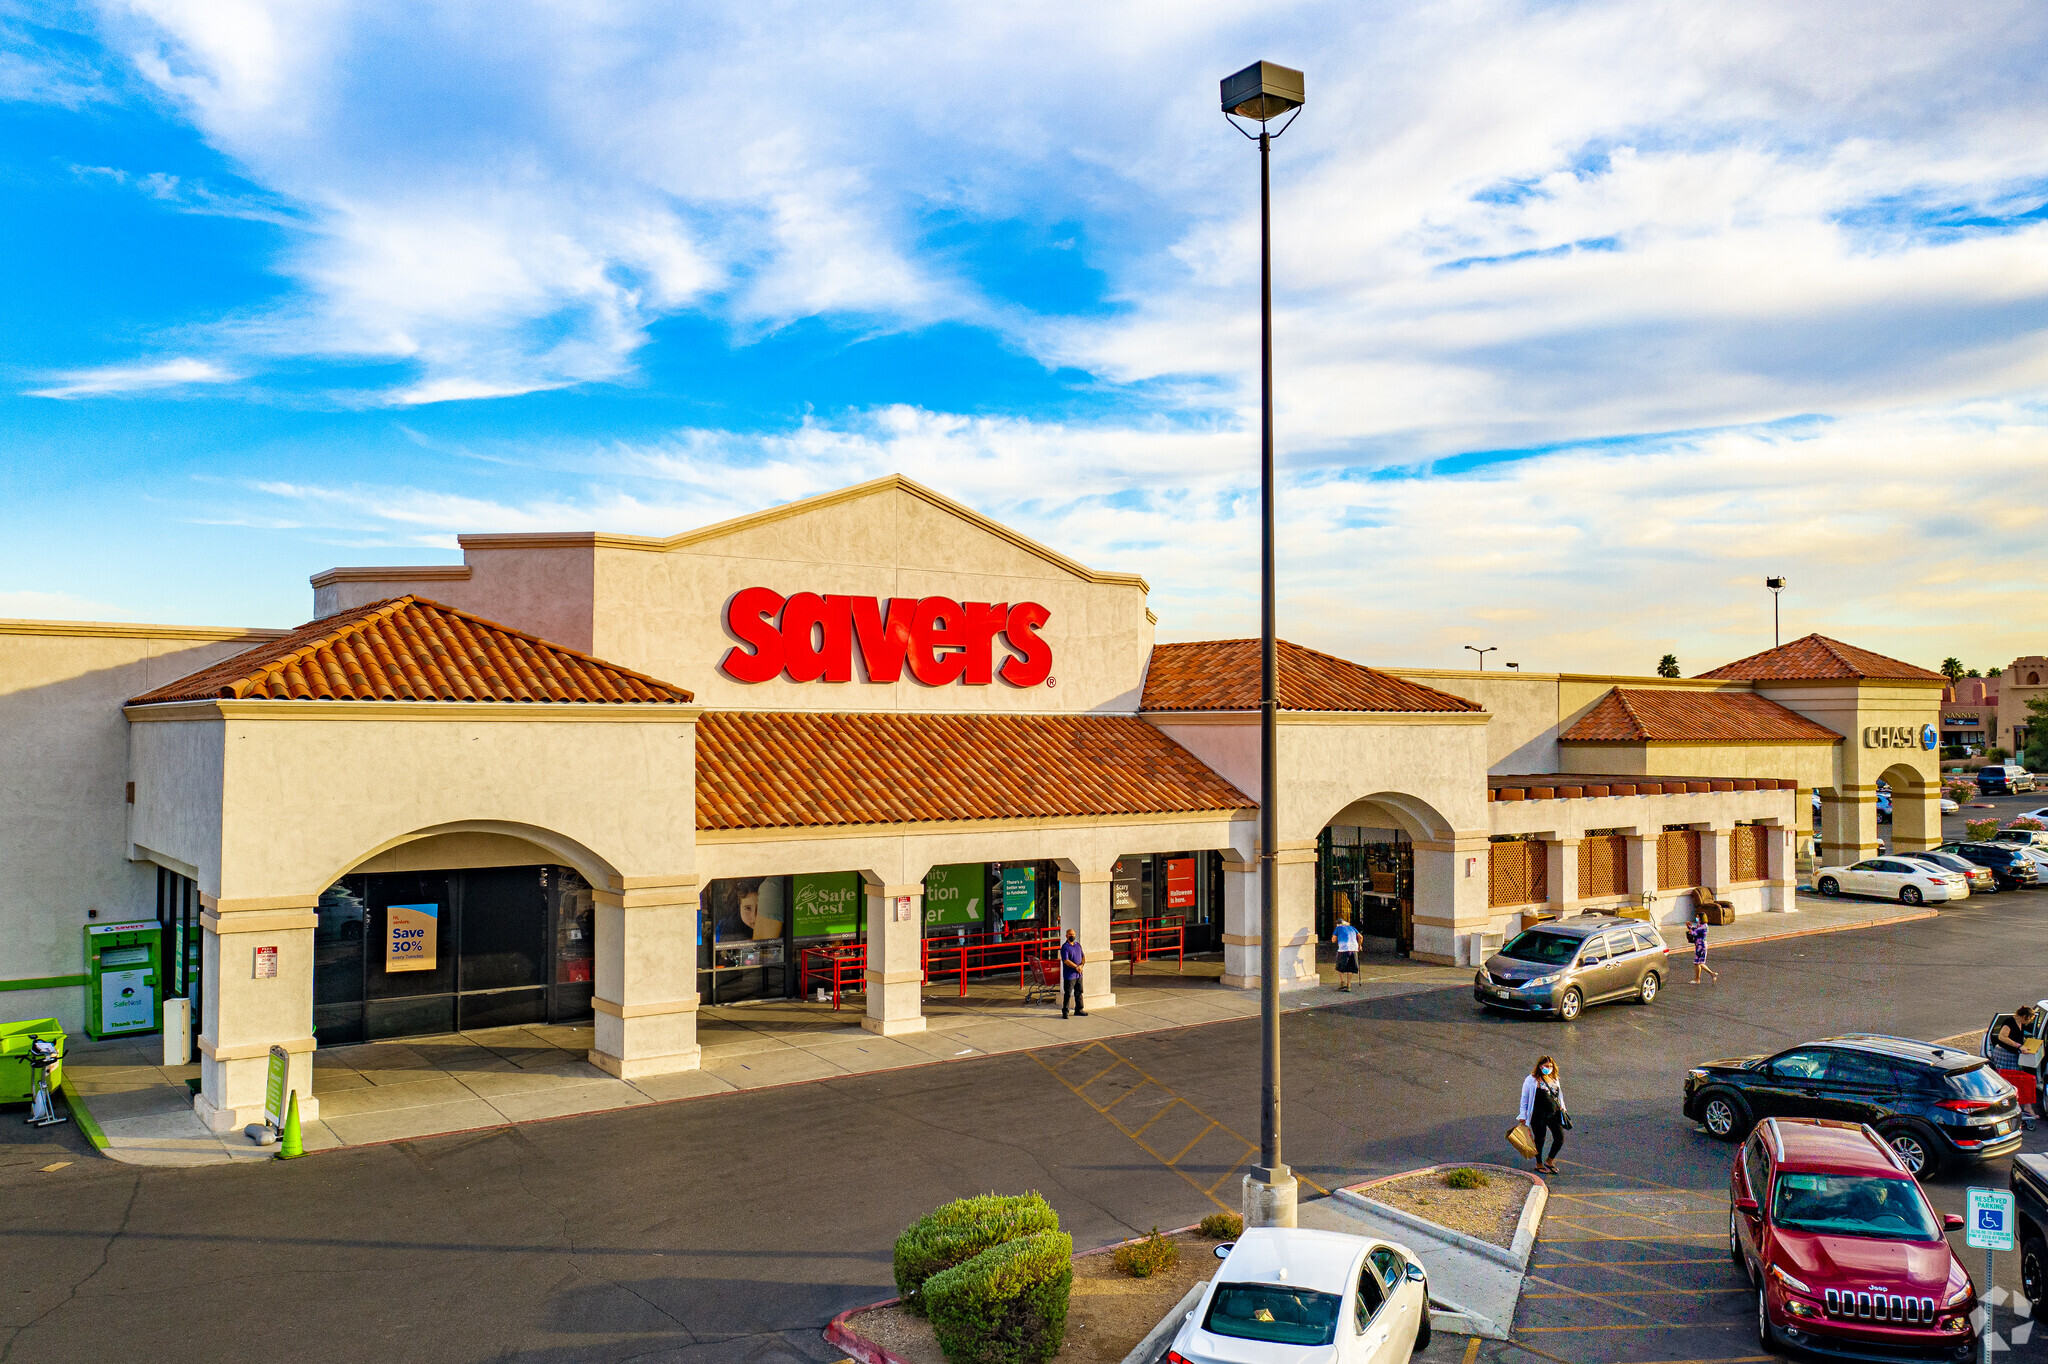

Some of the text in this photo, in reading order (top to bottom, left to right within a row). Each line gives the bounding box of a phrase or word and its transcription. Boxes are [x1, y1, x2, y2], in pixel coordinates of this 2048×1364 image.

[718, 586, 1053, 687] savers
[818, 888, 856, 903] Safe
[806, 901, 844, 916] Nest
[392, 928, 424, 939] Save
[392, 940, 422, 953] 30%
[114, 1000, 141, 1008] SafeNest
[1974, 1196, 2007, 1204] RESERVED
[1977, 1202, 2004, 1210] PARKING
[1868, 1284, 1888, 1292] Jeep
